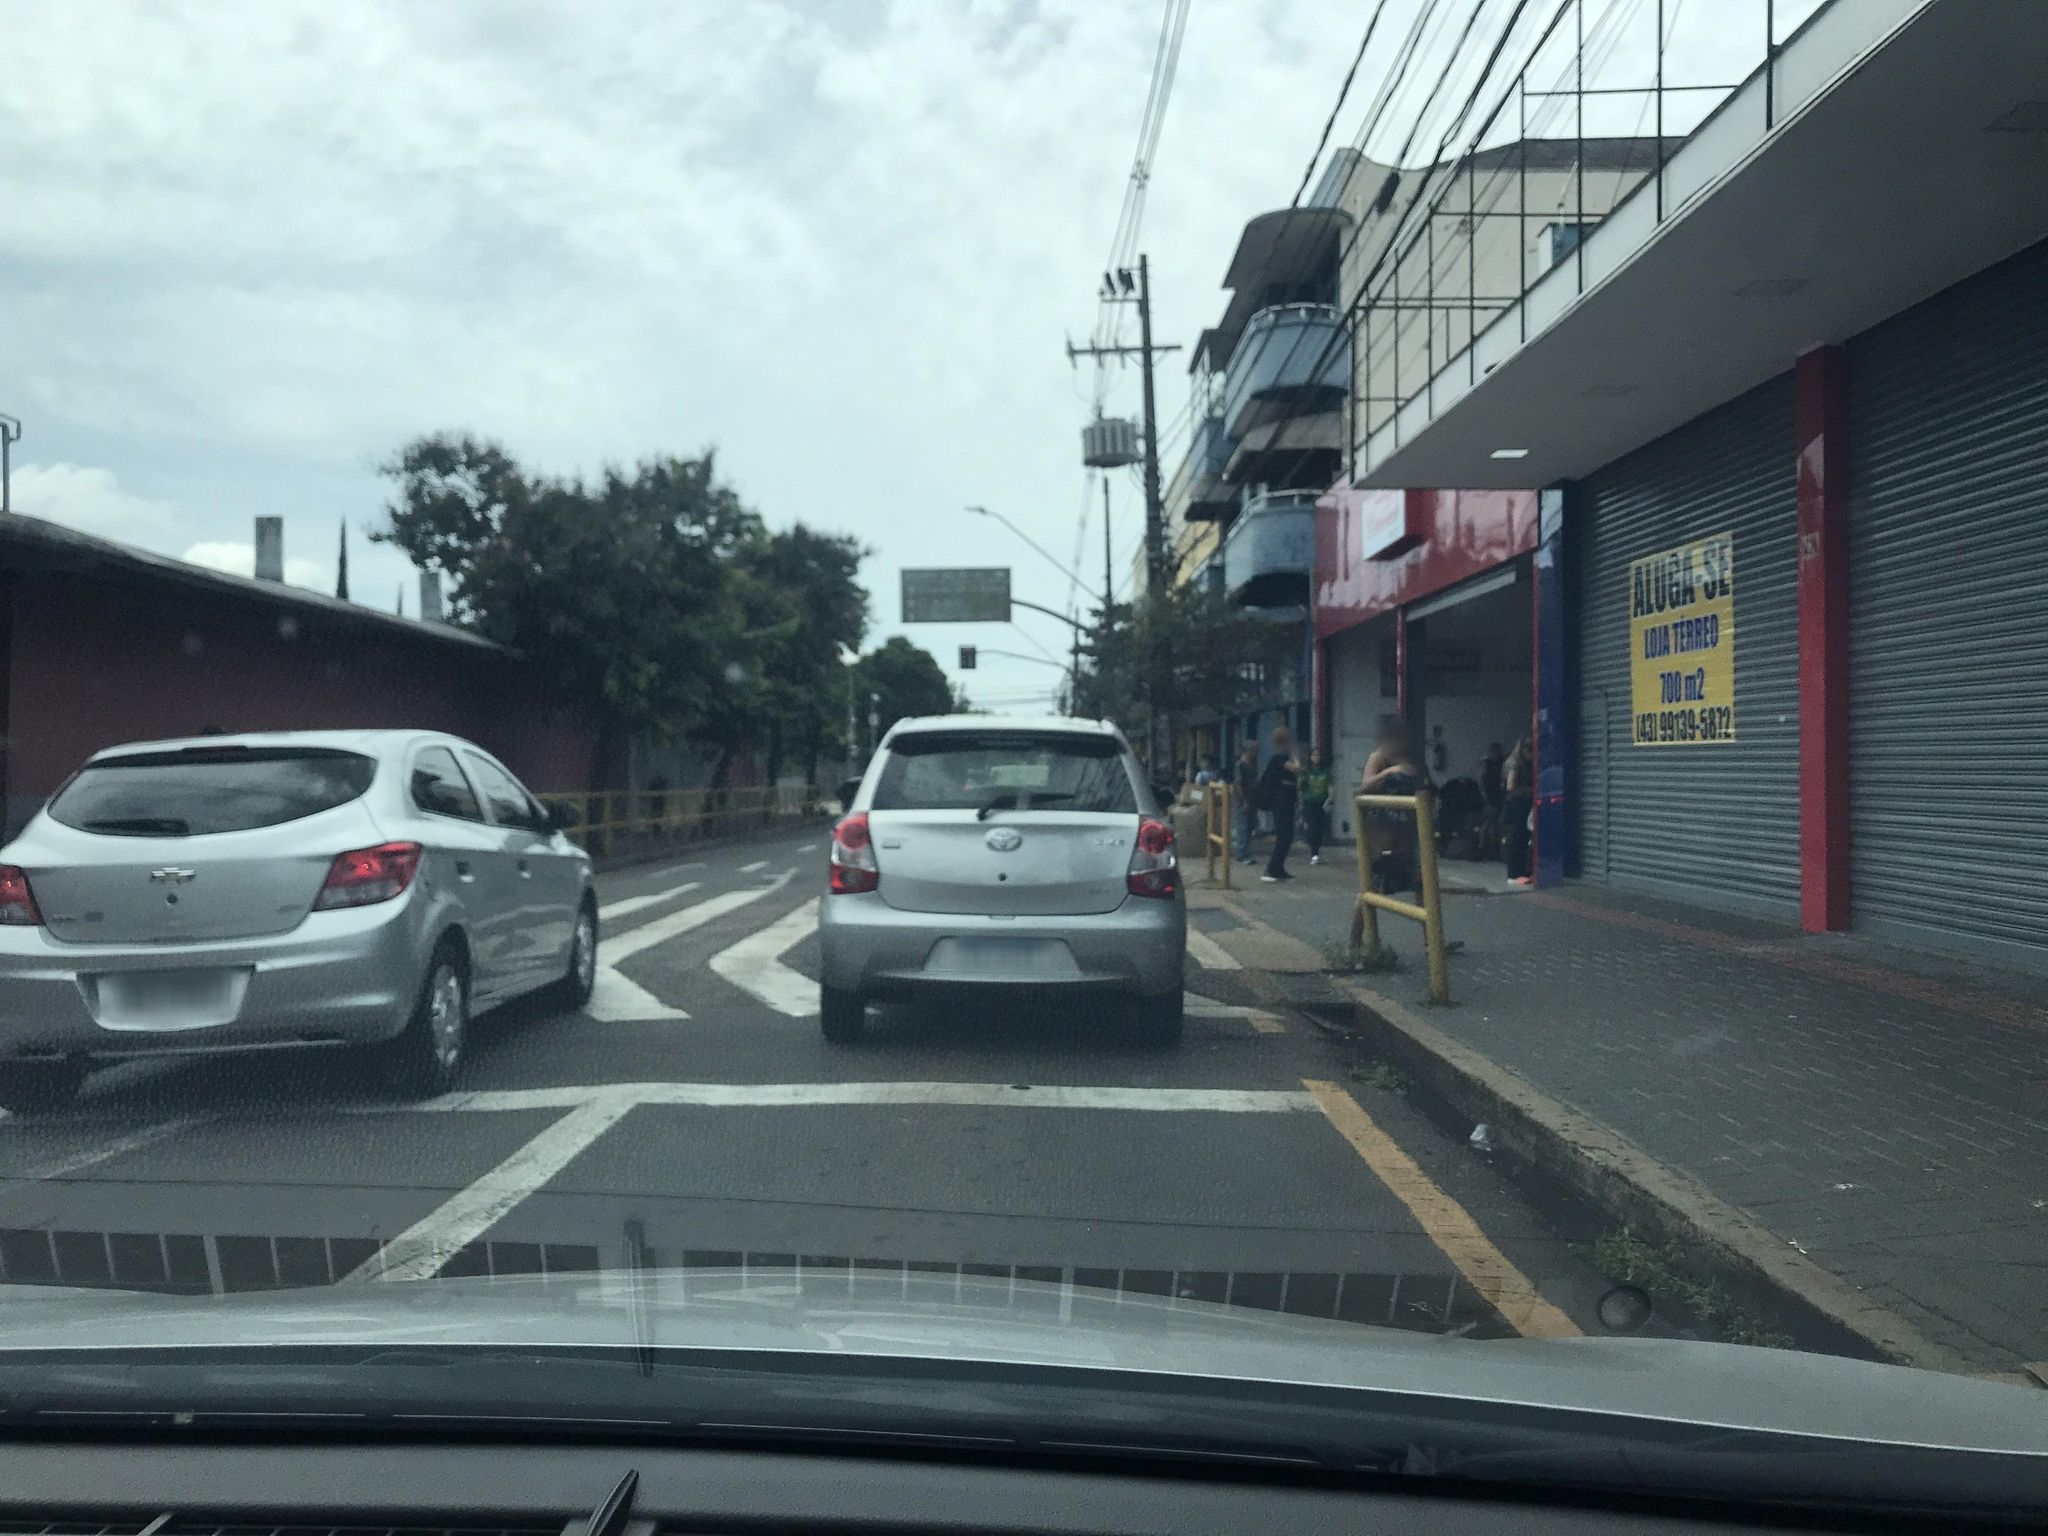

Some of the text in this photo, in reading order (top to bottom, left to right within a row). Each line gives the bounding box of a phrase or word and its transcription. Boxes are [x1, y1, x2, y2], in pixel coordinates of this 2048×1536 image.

[1633, 543, 1730, 617] ALUGA-SE
[1645, 625, 1670, 659] LOJA
[1660, 667, 1704, 703] 700 m2
[1637, 706, 1731, 742] (43) 99139-5872
